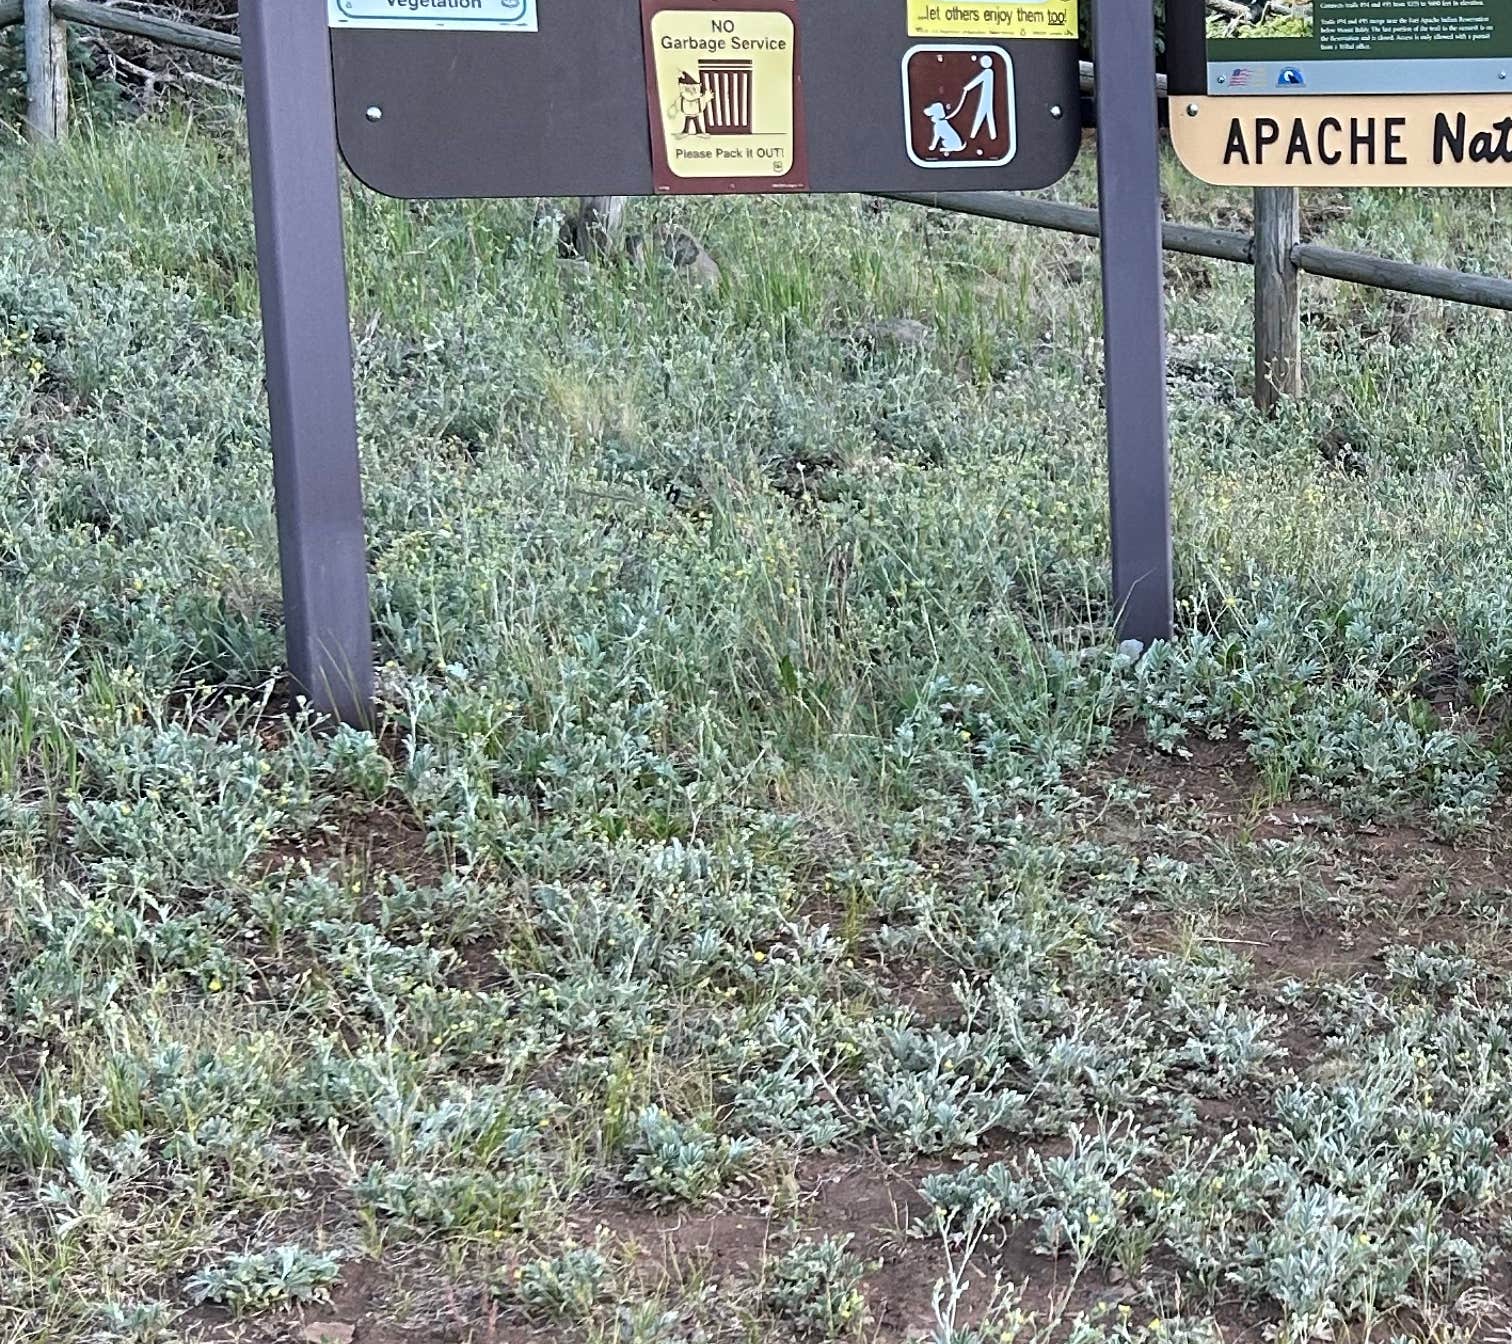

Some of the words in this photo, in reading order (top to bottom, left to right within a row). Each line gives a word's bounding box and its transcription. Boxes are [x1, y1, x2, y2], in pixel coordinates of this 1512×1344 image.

[945, 6, 980, 22] others
[983, 6, 1013, 26] enjoy
[1017, 7, 1044, 22] them
[1047, 8, 1067, 25] too!
[711, 20, 735, 34] NO
[661, 36, 727, 52] Garbage
[731, 36, 787, 50] Service
[1223, 116, 1406, 166] APACHE
[676, 149, 712, 159] Please
[715, 148, 743, 159] Pack
